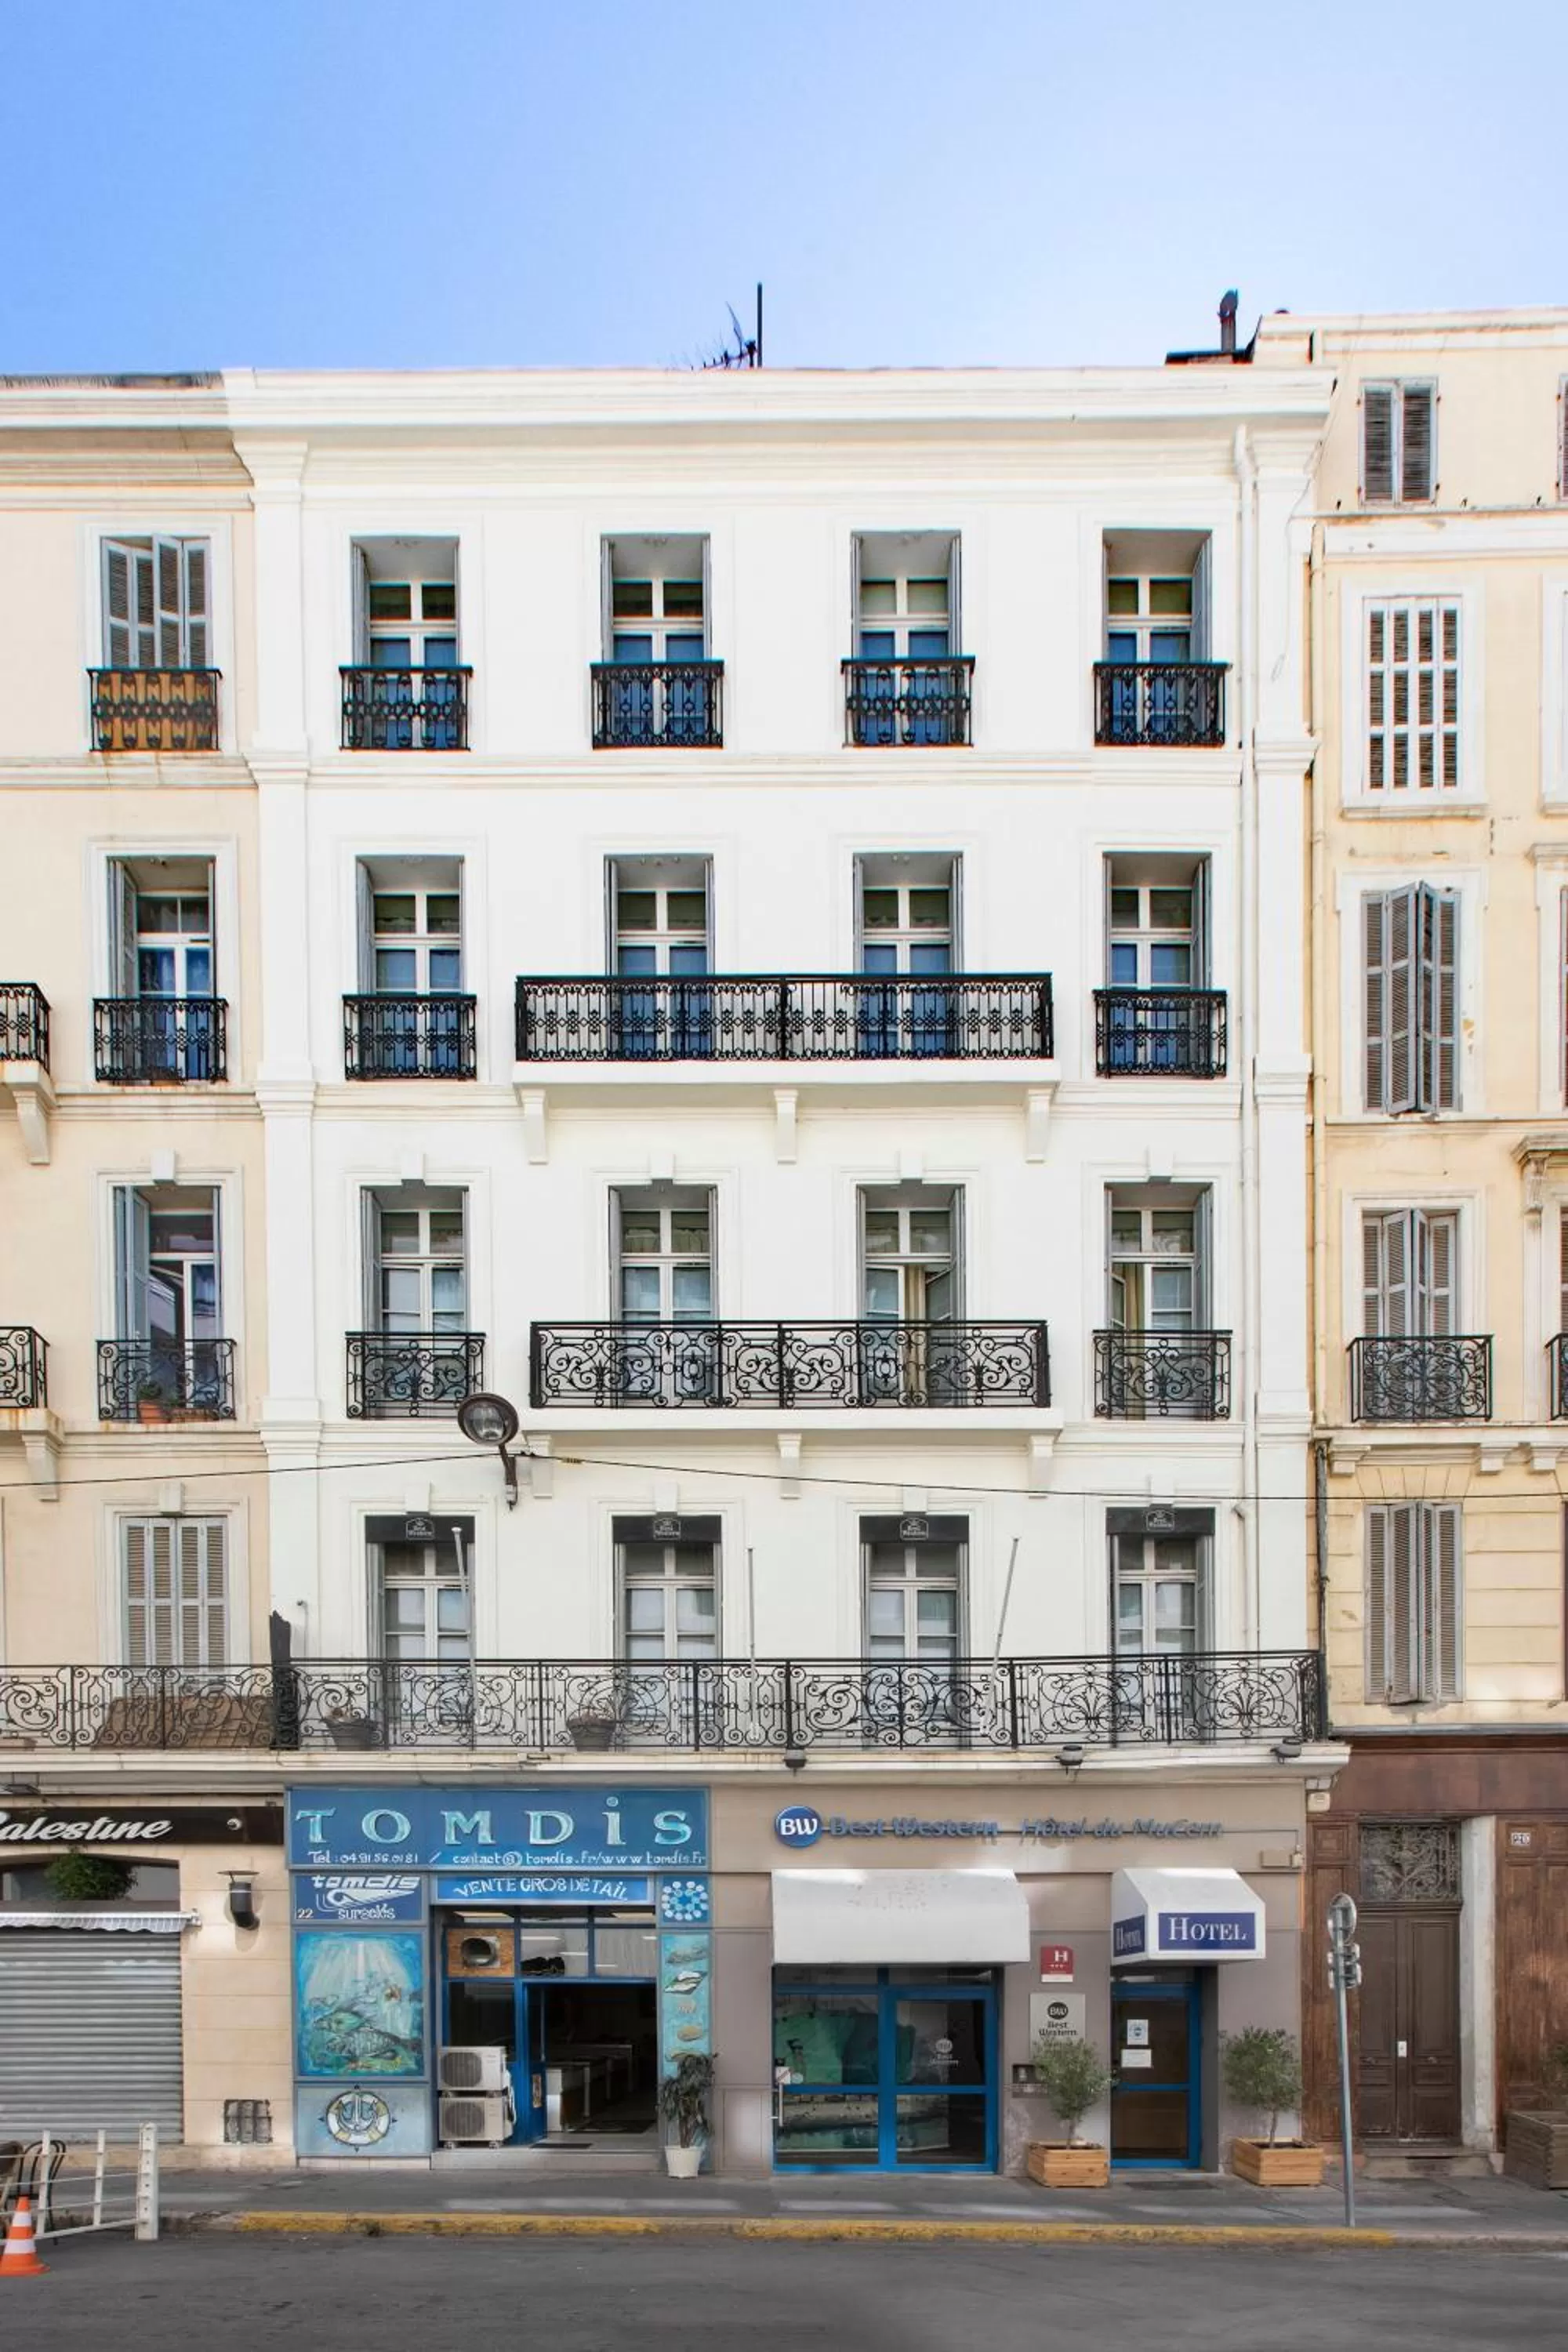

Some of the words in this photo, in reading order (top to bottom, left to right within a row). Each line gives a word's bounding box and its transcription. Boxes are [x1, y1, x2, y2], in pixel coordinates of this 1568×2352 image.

[780, 1818, 818, 1835] BW
[829, 1817, 886, 1835] Best
[892, 1817, 999, 1836] Western
[1094, 1817, 1123, 1837] du
[311, 1875, 420, 1888] tomdis
[453, 1878, 516, 1897] VENTE
[520, 1878, 567, 1892] GROS
[297, 1908, 314, 1918] 22
[1054, 1950, 1068, 1962] H
